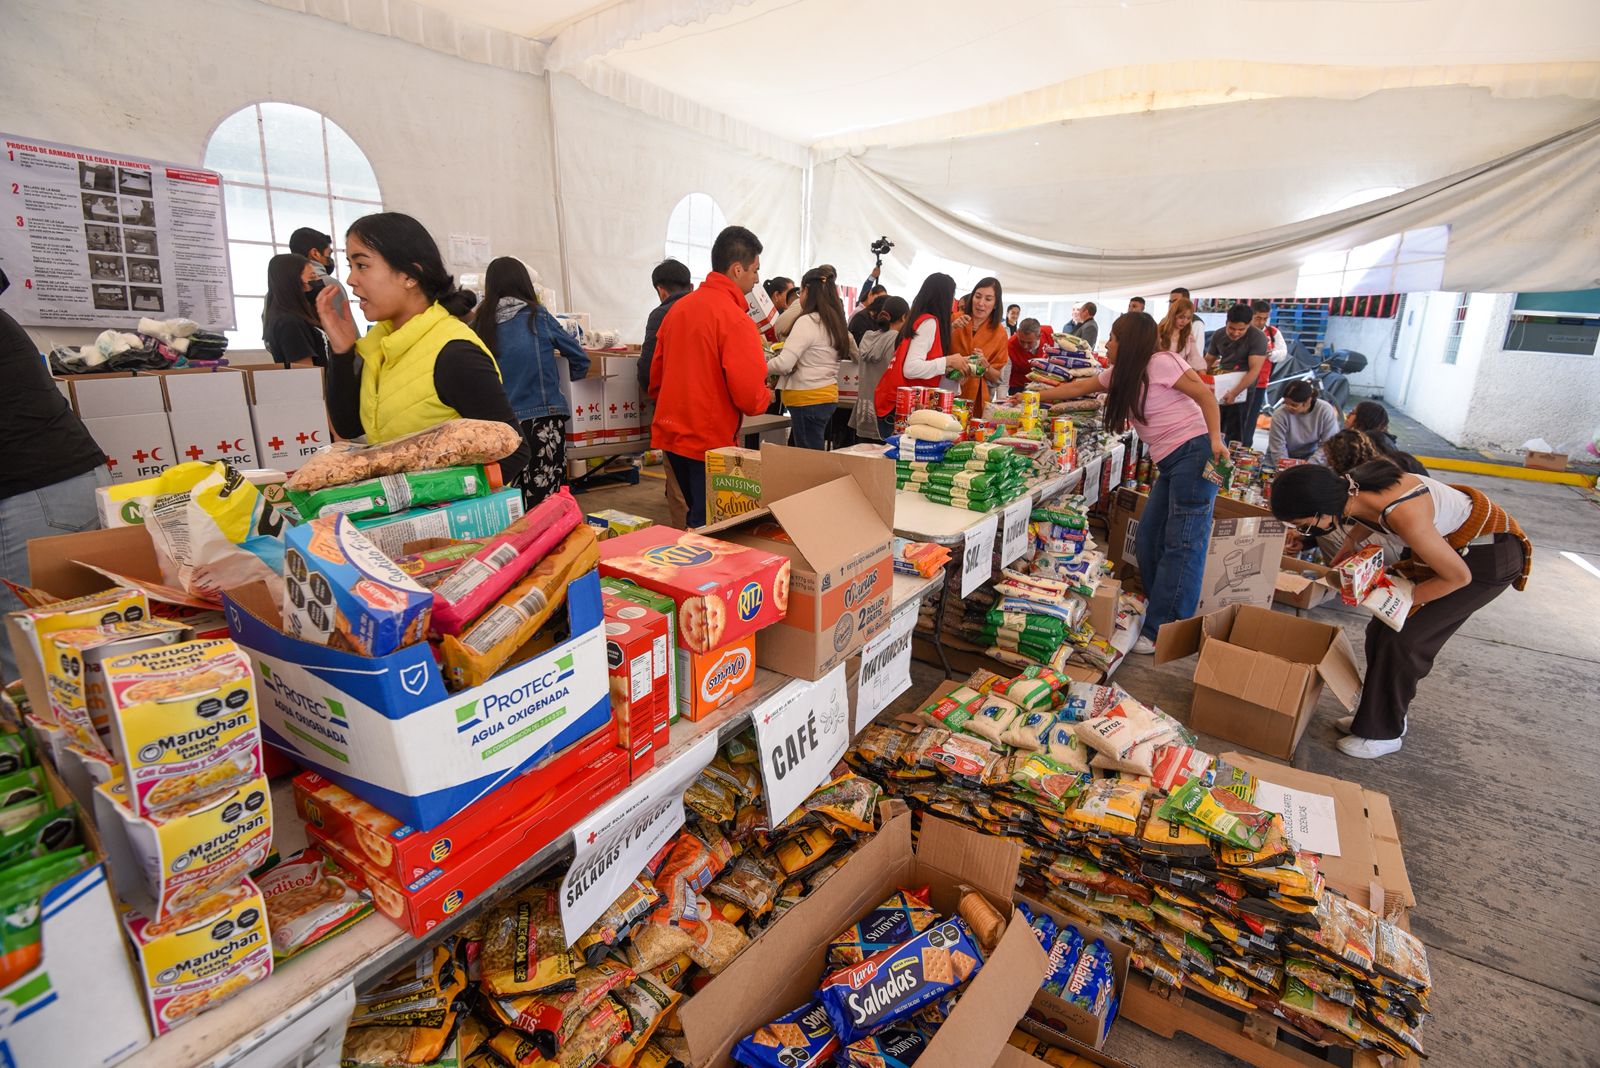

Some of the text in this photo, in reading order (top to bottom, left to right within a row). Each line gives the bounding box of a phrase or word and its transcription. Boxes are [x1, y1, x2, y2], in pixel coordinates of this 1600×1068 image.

[6, 141, 152, 170] PROCESO DE ARMADO DE LA CAJA DE ALIMENTOS
[8, 150, 14, 161] 1
[12, 182, 19, 194] 2
[16, 216, 24, 227] 3
[25, 279, 32, 289] 4
[299, 445, 324, 457] IFR
[644, 544, 709, 567] RITZ
[739, 584, 762, 621] RITZ
[858, 597, 885, 631] 2 ROLLOS
[866, 608, 883, 625] GRATIS
[132, 639, 224, 661] Maruchan
[151, 657, 202, 671] Lunch
[471, 686, 570, 747] AGUA OXIGENADA
[1099, 719, 1122, 736] Arroz
[158, 714, 248, 750] Maruchan
[176, 735, 220, 755] Instant
[182, 744, 217, 760] Lunch
[771, 709, 818, 781] CAFÉ
[598, 795, 650, 835] CRUZ ROJA MEXICANA
[189, 815, 264, 857] Maruchan
[170, 871, 199, 885] Sabor
[207, 855, 237, 873] Carne
[250, 831, 268, 847] Res
[203, 839, 239, 860] Instant
[567, 845, 621, 908] SALADAS
[625, 835, 632, 849] Y
[263, 873, 313, 899] oditos
[866, 911, 905, 942] SALADITAS
[176, 932, 259, 971] Maruchan
[192, 955, 232, 975] Instant
[198, 962, 230, 977] Lunch
[853, 962, 876, 988] Lara
[1070, 953, 1095, 995] Saladas
[849, 968, 918, 1025] Saladas
[886, 1033, 922, 1057] SALADITAS
